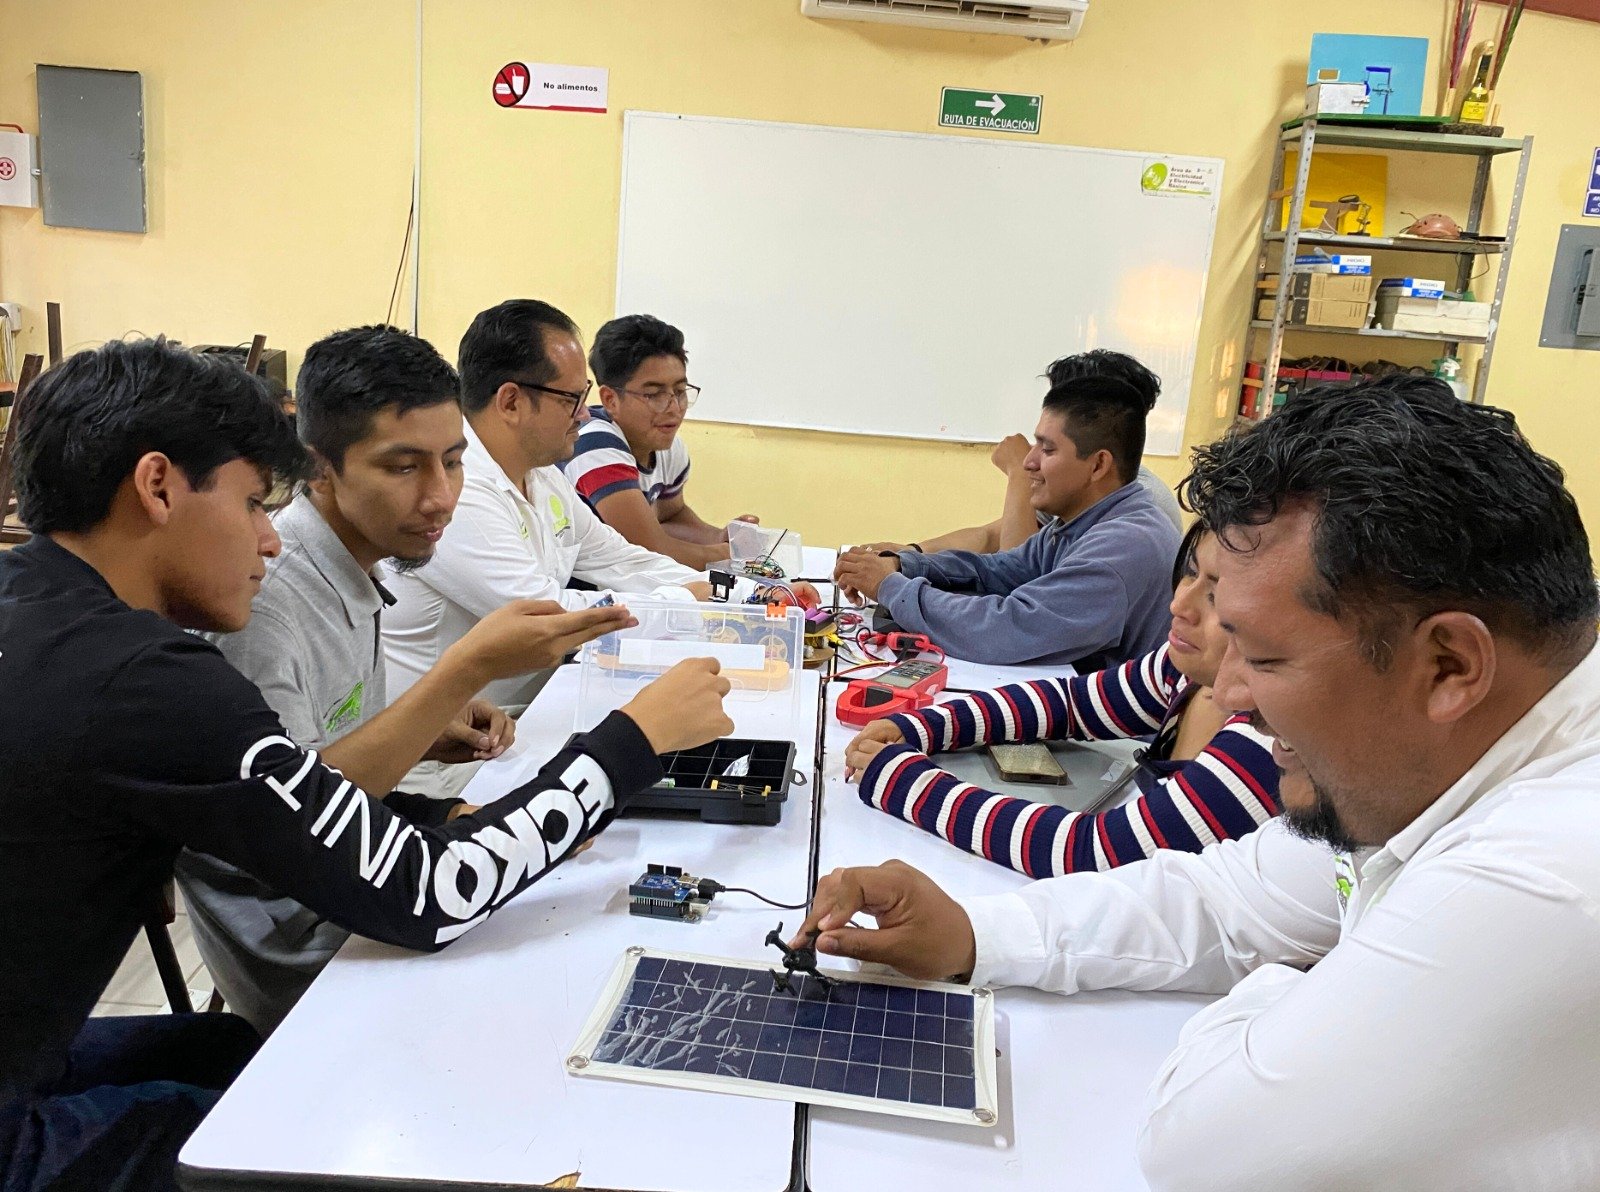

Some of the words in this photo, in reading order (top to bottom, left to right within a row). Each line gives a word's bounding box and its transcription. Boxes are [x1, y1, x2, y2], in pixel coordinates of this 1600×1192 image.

[543, 82, 555, 90] No
[556, 83, 598, 92] alimentos
[944, 114, 964, 124] RUTA
[966, 115, 978, 126] DE
[979, 116, 1034, 130] EVACUACIÓN
[434, 753, 615, 920] ECKO
